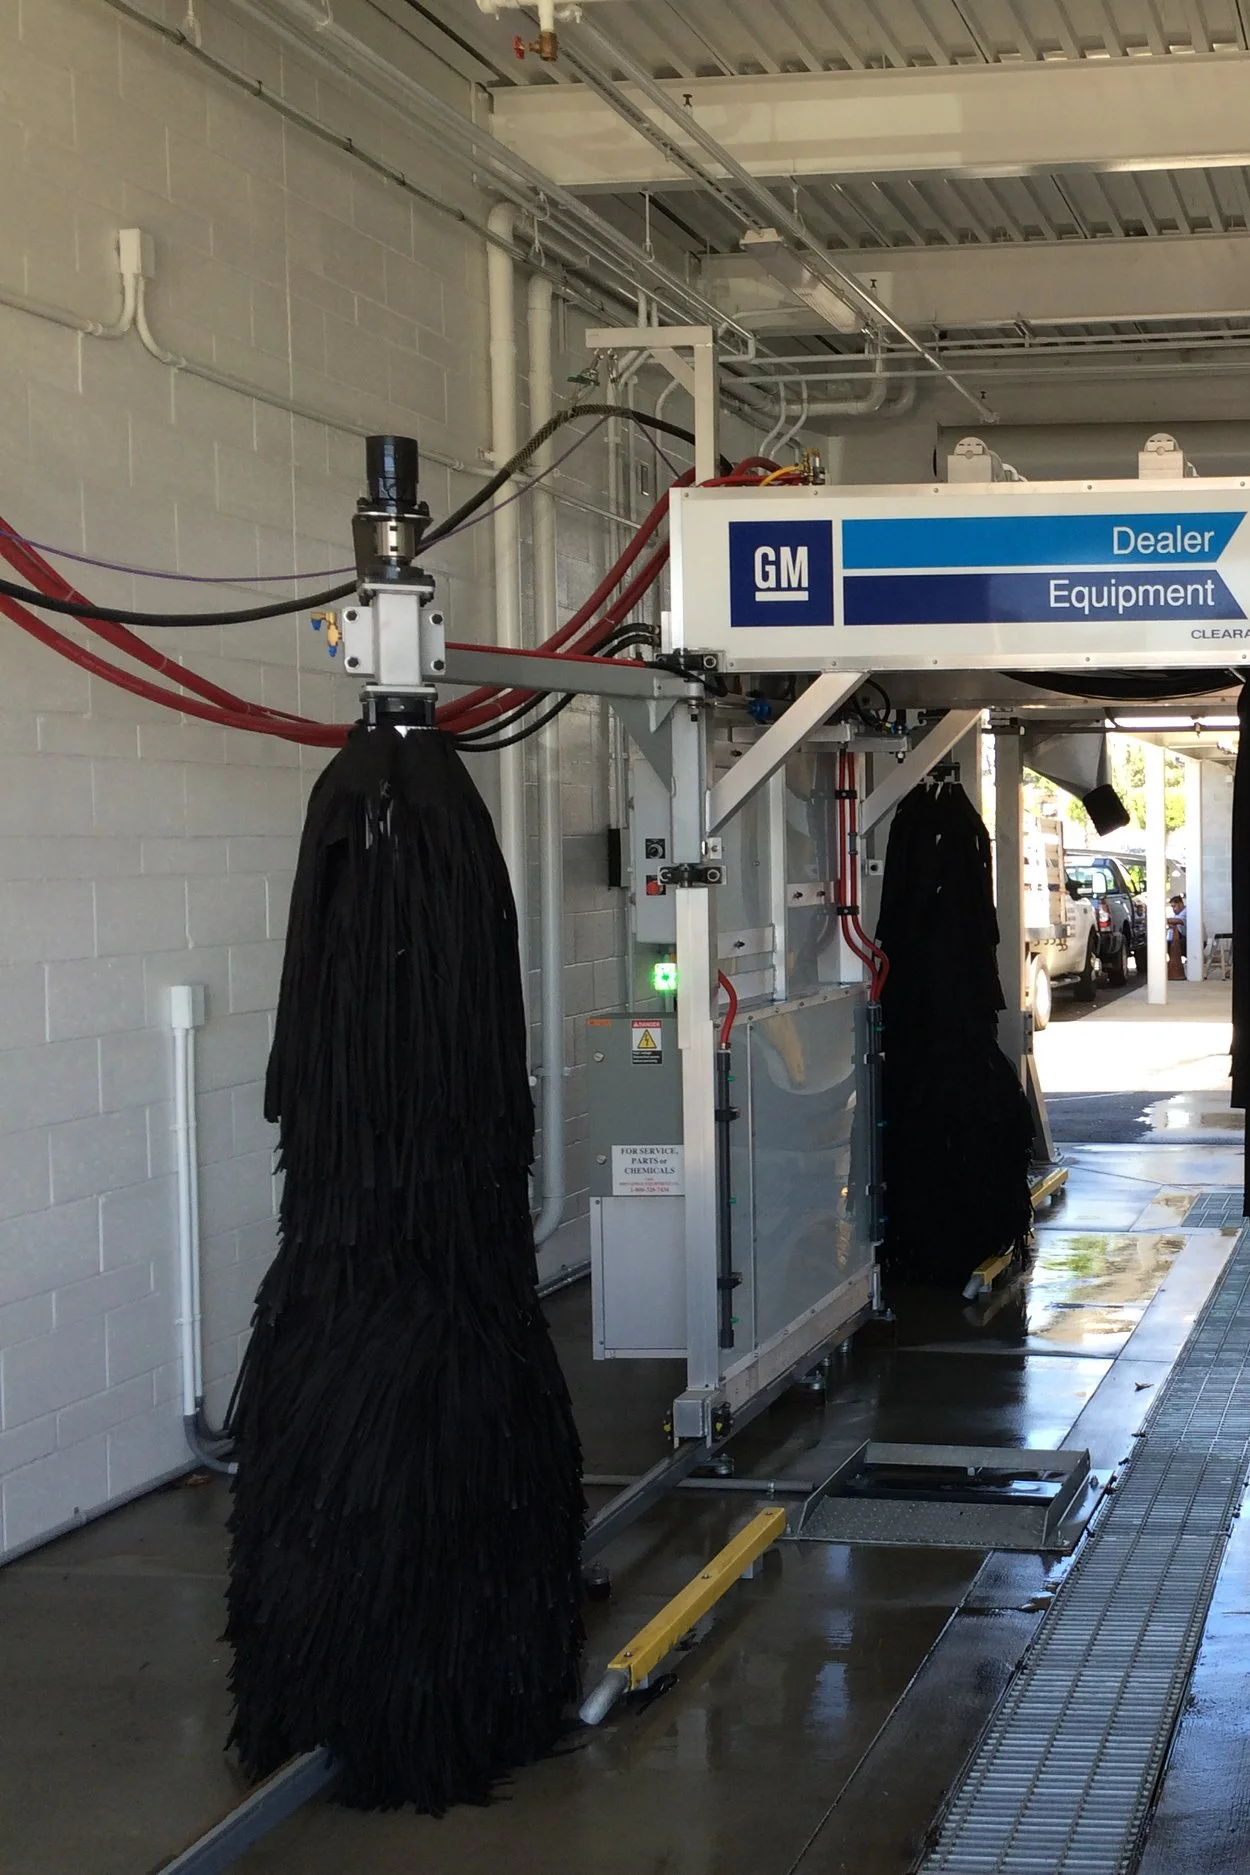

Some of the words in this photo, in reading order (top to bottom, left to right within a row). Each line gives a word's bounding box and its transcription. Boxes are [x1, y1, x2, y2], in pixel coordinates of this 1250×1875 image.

[1112, 524, 1215, 555] Dealer
[753, 545, 809, 589] GM
[1049, 578, 1215, 610] Equipment
[621, 1147, 638, 1155] FOR
